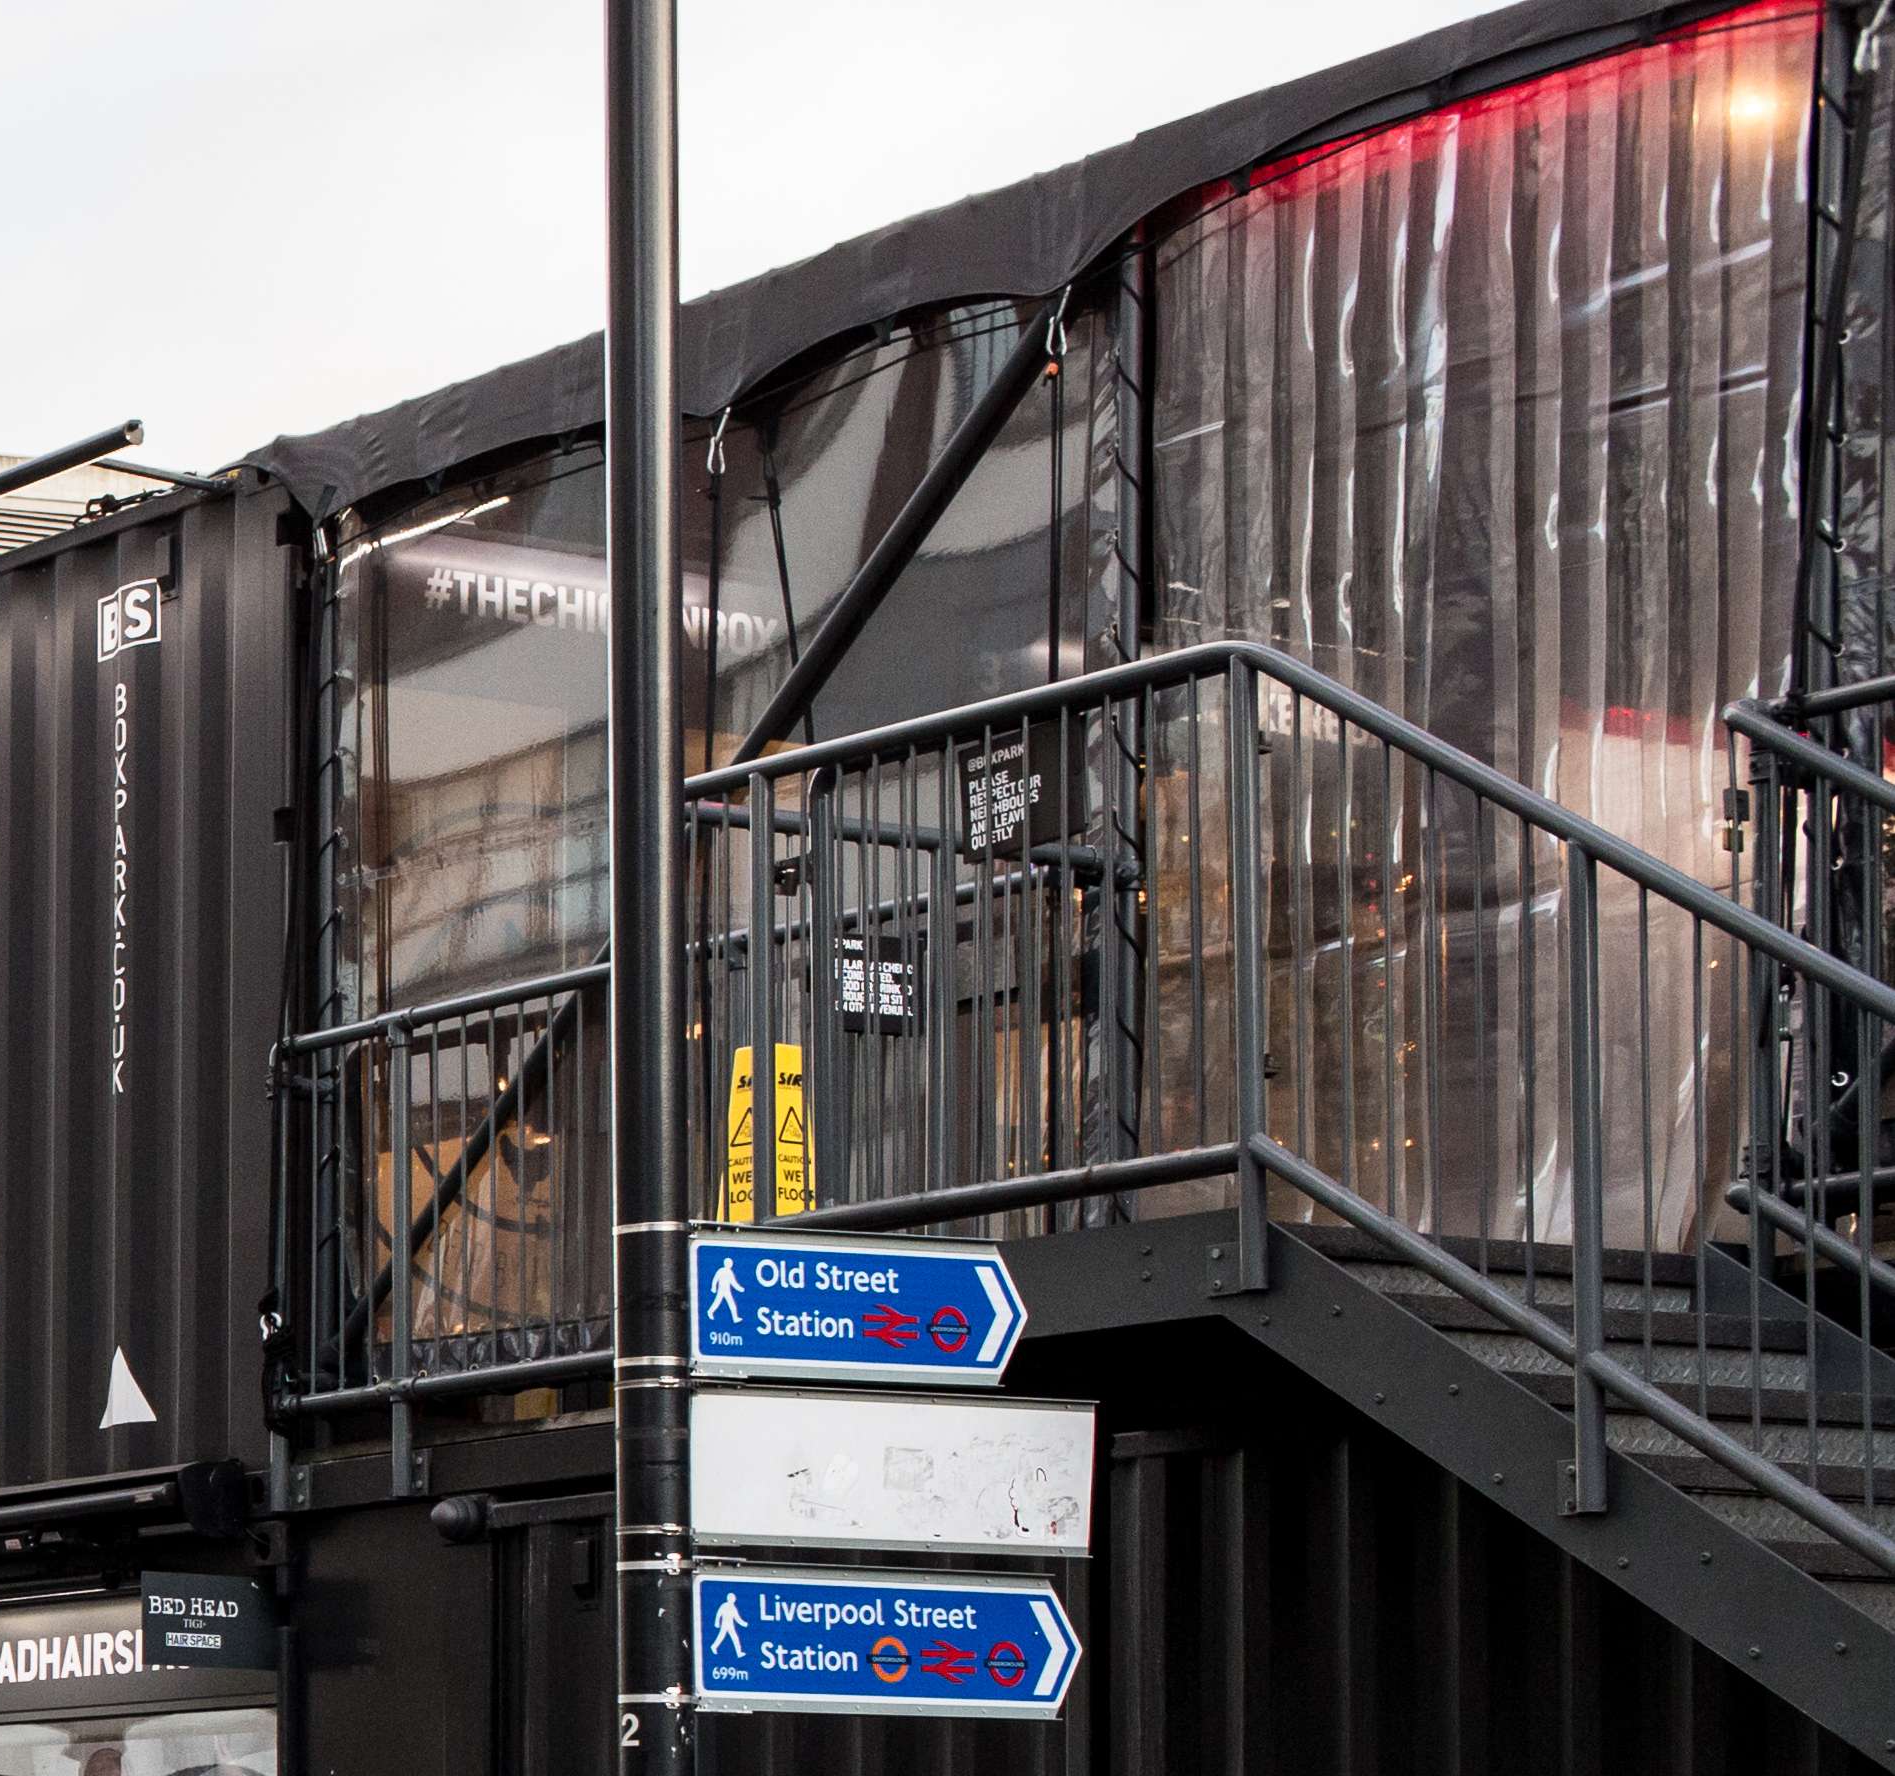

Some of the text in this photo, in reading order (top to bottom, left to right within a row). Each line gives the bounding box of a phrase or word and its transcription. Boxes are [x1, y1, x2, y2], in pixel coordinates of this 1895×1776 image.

[755, 1258, 899, 1294] Old Street
[709, 1331, 744, 1347] 910m
[756, 1306, 854, 1340] Station
[148, 1595, 239, 1618] BED HEAD
[759, 1593, 978, 1631] Liverpool Street
[167, 1634, 220, 1649] HAIR SPACE
[760, 1640, 858, 1673] Station
[712, 1665, 749, 1682] 699m
[621, 1713, 640, 1748] 2
